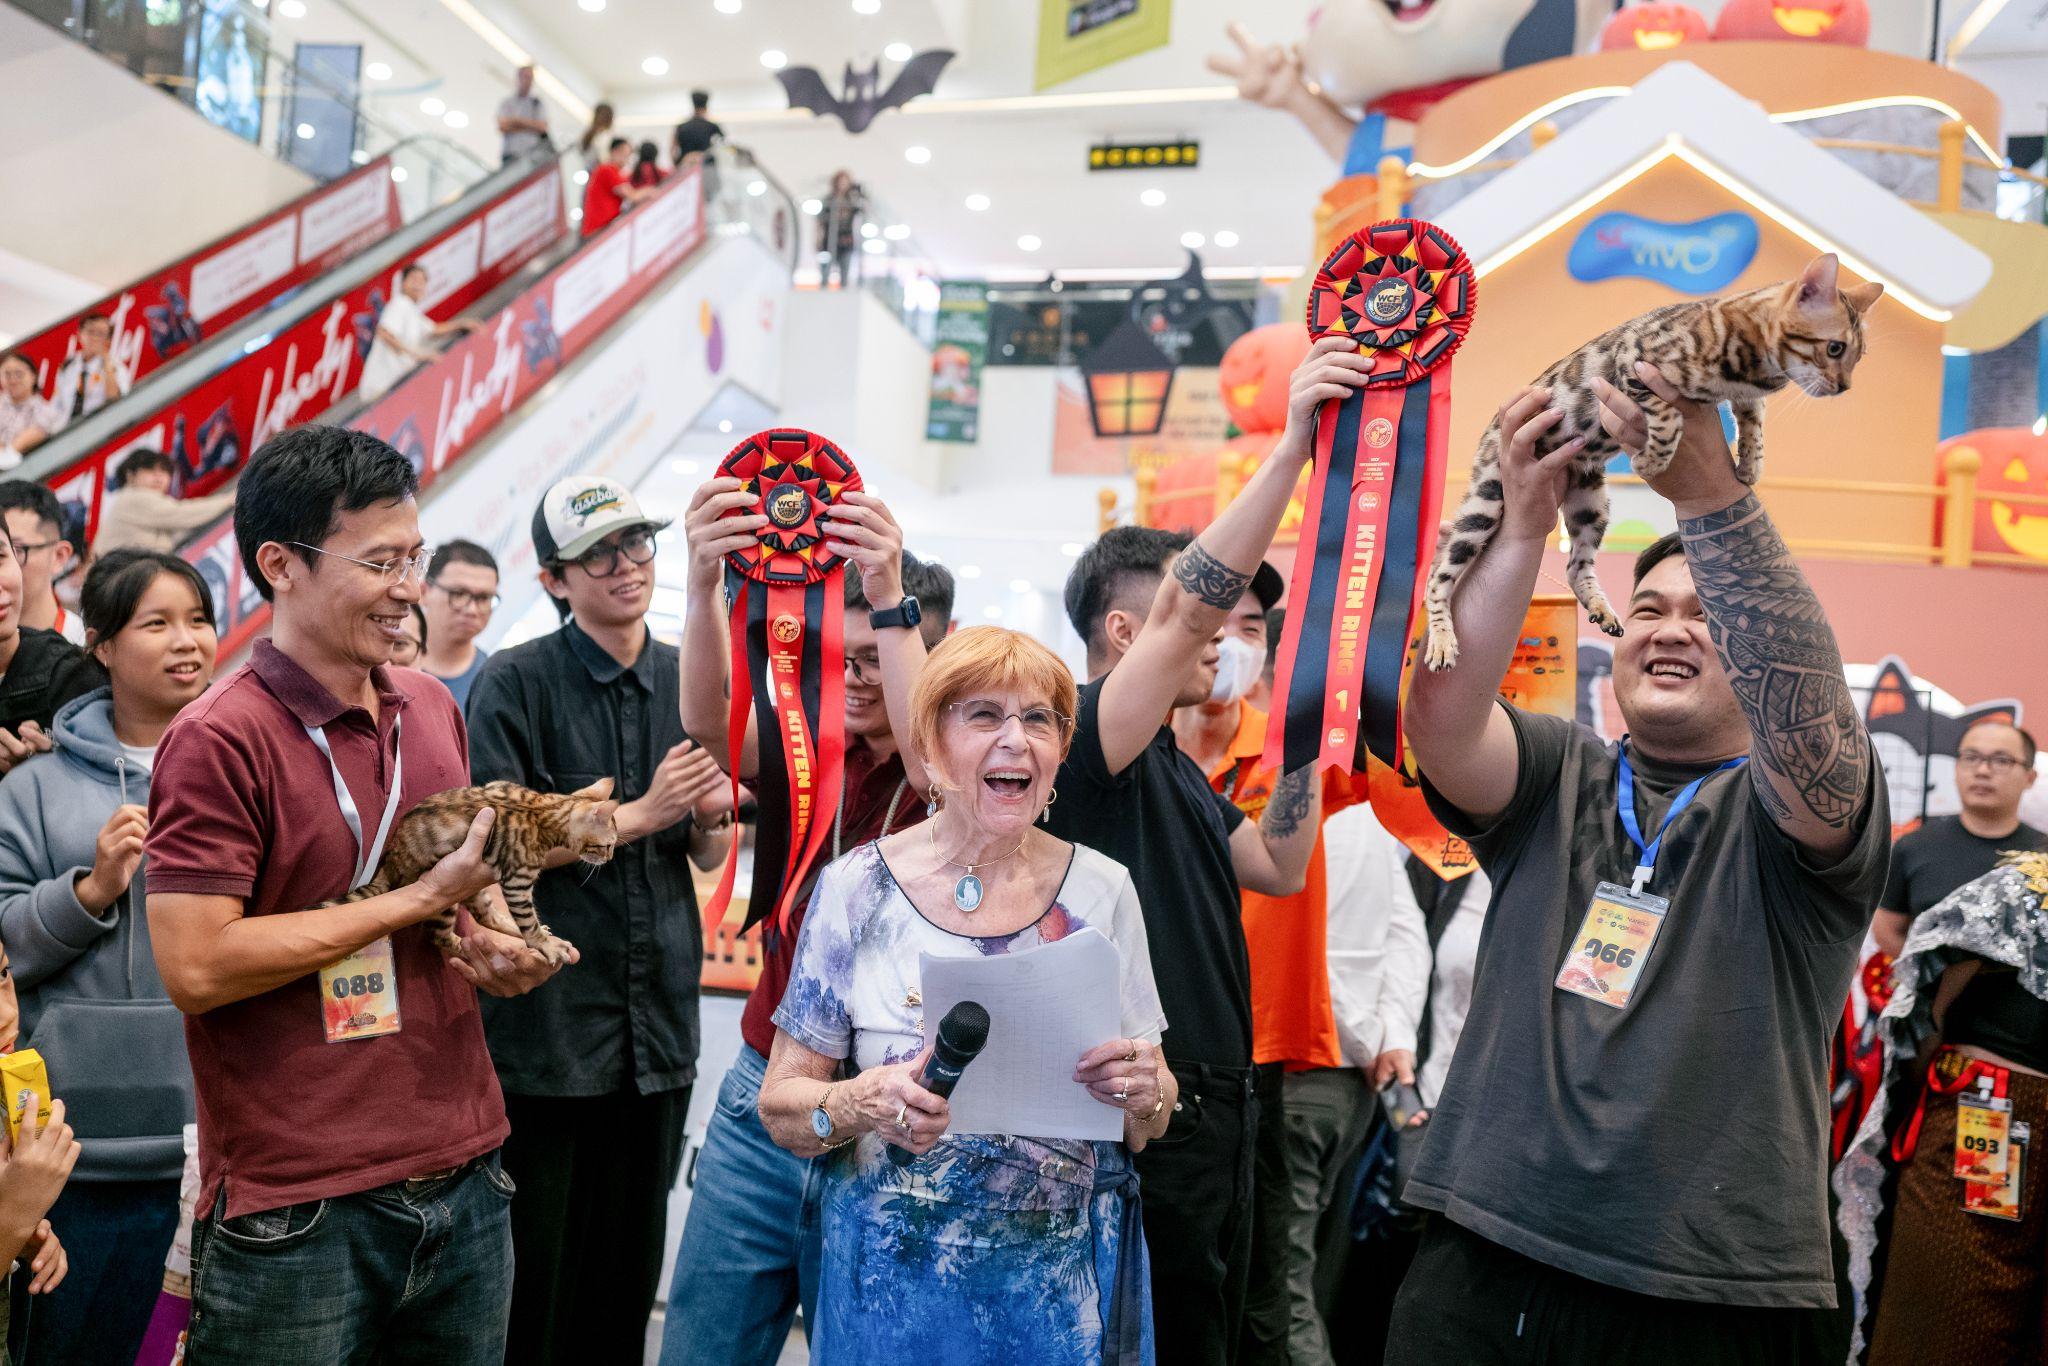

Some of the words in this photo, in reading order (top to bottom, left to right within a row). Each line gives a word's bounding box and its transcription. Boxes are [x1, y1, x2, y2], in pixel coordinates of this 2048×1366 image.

[1378, 294, 1401, 302] WCF
[778, 500, 799, 508] WCF
[1346, 524, 1376, 609] KITTEN
[1336, 615, 1360, 676] RING
[1335, 689, 1348, 713] 1
[786, 709, 811, 789] KITTEN
[1584, 938, 1636, 968] 066
[333, 972, 385, 999] 088
[1964, 1135, 1999, 1154] 093
